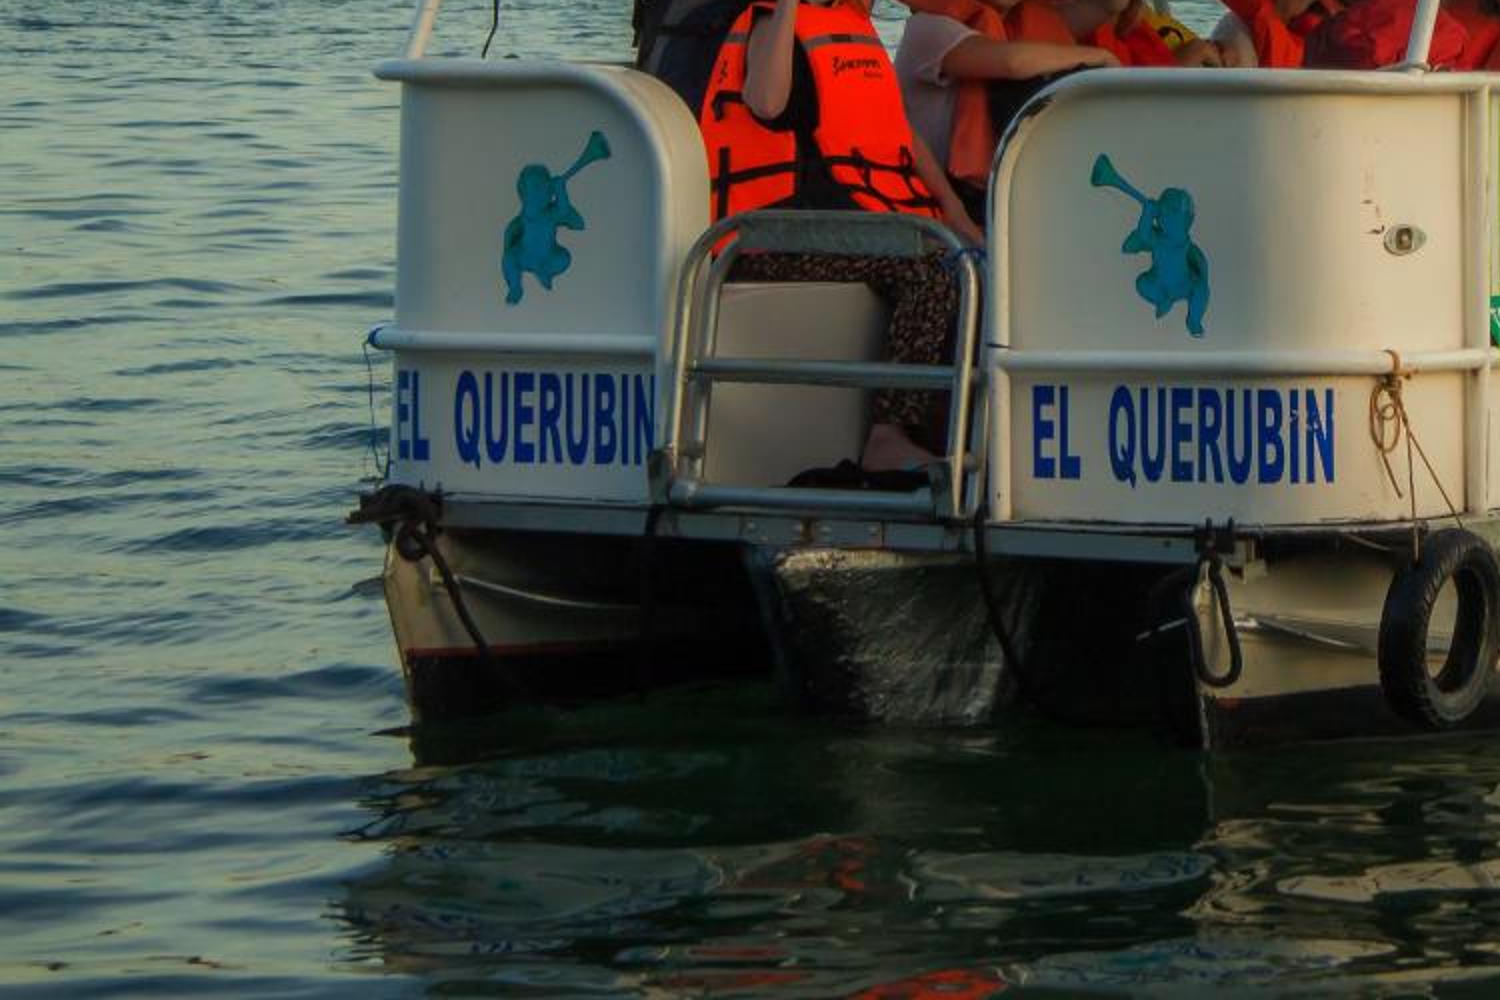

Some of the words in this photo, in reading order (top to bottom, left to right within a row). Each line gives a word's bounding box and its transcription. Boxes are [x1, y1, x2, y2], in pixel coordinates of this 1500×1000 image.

[397, 369, 430, 461] EL
[454, 369, 656, 471] QUERUBIN
[1032, 385, 1081, 480] EL
[1108, 384, 1335, 489] QUERUBIN
